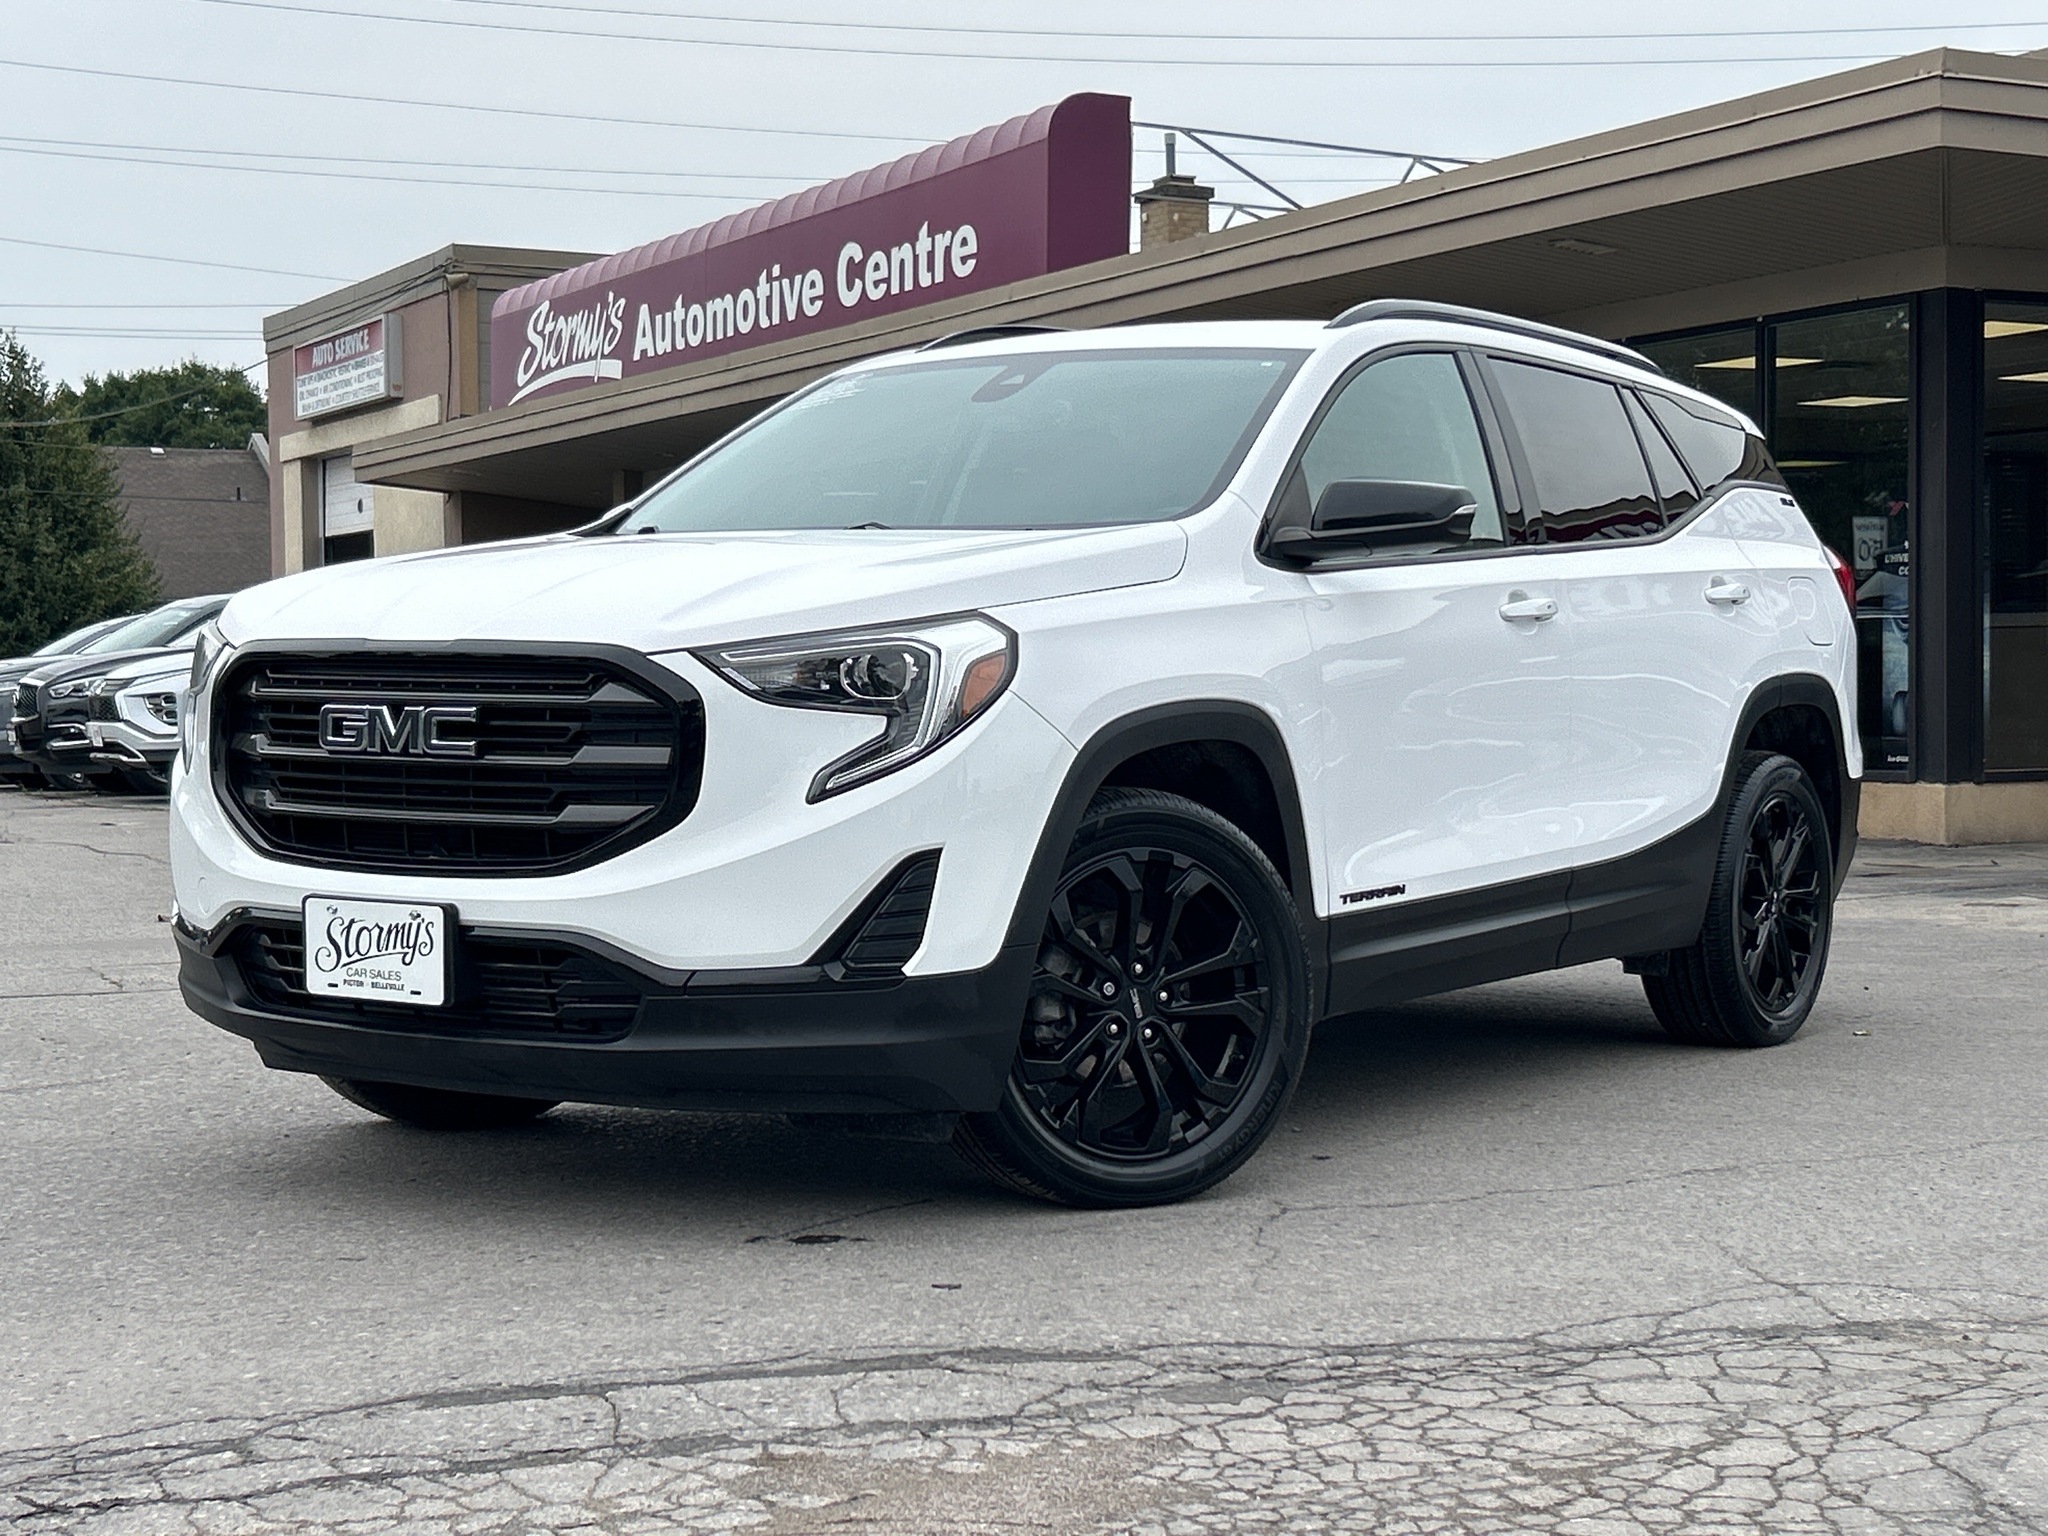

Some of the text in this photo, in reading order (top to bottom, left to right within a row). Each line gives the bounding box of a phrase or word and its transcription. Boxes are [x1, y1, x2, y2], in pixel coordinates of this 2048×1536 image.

[513, 220, 978, 388] Stormy's Automotive Centre
[312, 328, 370, 368] AUTO SERVICE
[319, 704, 477, 756] GMC
[1339, 884, 1406, 905] TERRAIN
[315, 916, 434, 972] Stormy's
[346, 967, 402, 981] CAR SALES
[1234, 1080, 1283, 1149] KINERGY
